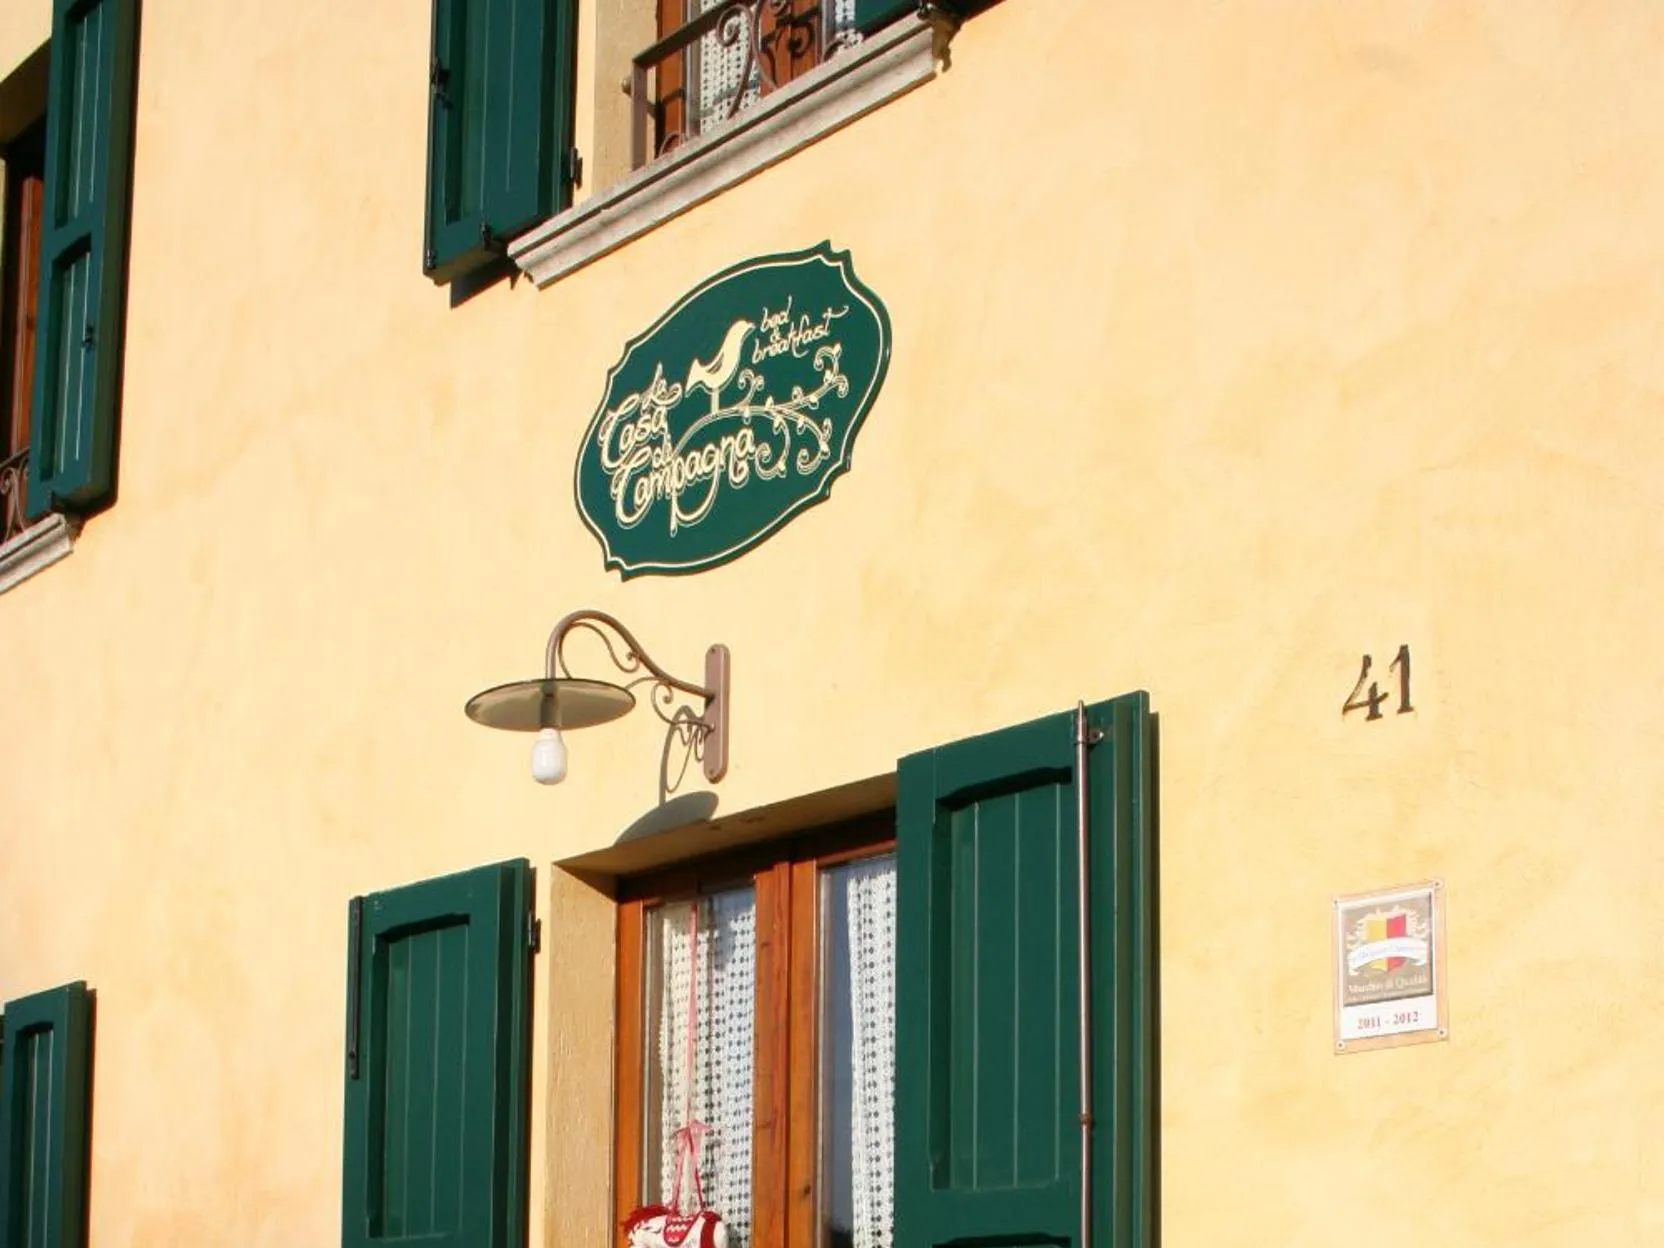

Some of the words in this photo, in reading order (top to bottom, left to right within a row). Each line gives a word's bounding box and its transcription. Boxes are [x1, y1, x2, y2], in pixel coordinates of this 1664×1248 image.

[752, 305, 849, 364] breakfast
[760, 294, 792, 333] bed
[598, 393, 669, 473] Casa
[611, 428, 755, 537] Campagna
[1342, 644, 1414, 721] 41
[1357, 1015, 1381, 1030] 2011
[1393, 1010, 1419, 1026] 2012
